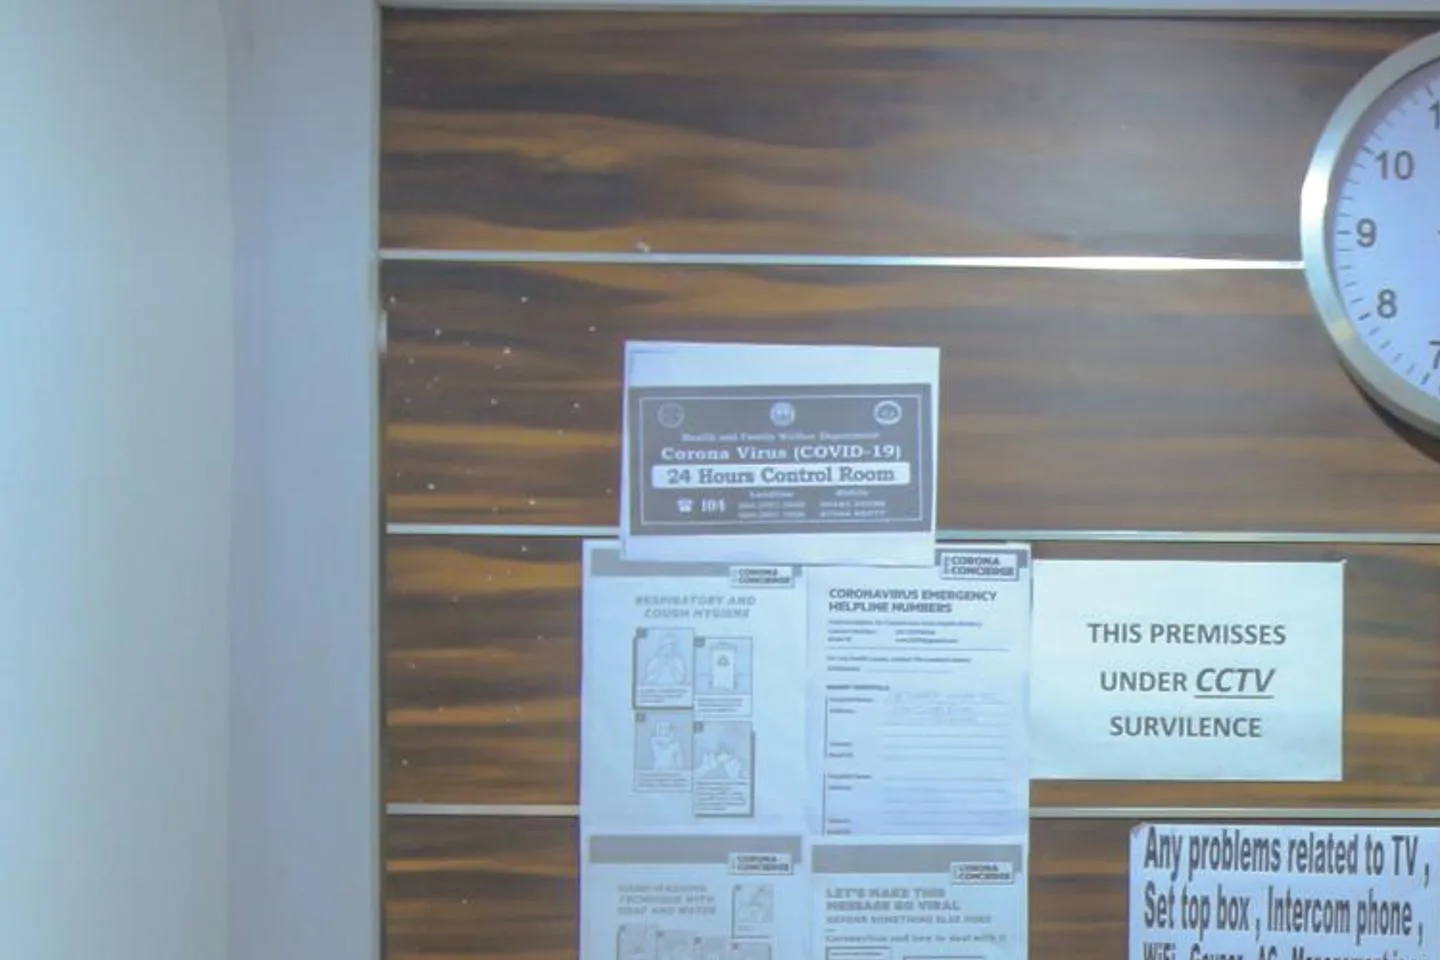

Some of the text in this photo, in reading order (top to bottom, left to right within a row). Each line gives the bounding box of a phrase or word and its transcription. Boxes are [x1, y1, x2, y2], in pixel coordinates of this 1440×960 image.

[1375, 150, 1414, 180] 10
[1356, 218, 1377, 248] 9
[1377, 289, 1397, 318] 8
[661, 443, 902, 462] Corona Virus (COVID-19)
[667, 466, 896, 485] 24 Hours Control Room
[828, 588, 998, 602] CORONAVIRUS EMERGENCY
[828, 602, 889, 613] HELPLINE
[1087, 623, 1287, 646] THIS PREMISSES
[1100, 668, 1277, 695] UNDER CCTV
[1109, 716, 1262, 738] SURVILENCE
[1144, 827, 1183, 881] Any
[1188, 829, 1282, 881] problems
[1287, 832, 1358, 875] related
[1365, 836, 1385, 876] to
[1144, 882, 1175, 931] Set
[1180, 888, 1211, 941] top
[1266, 885, 1350, 934] Intercom
